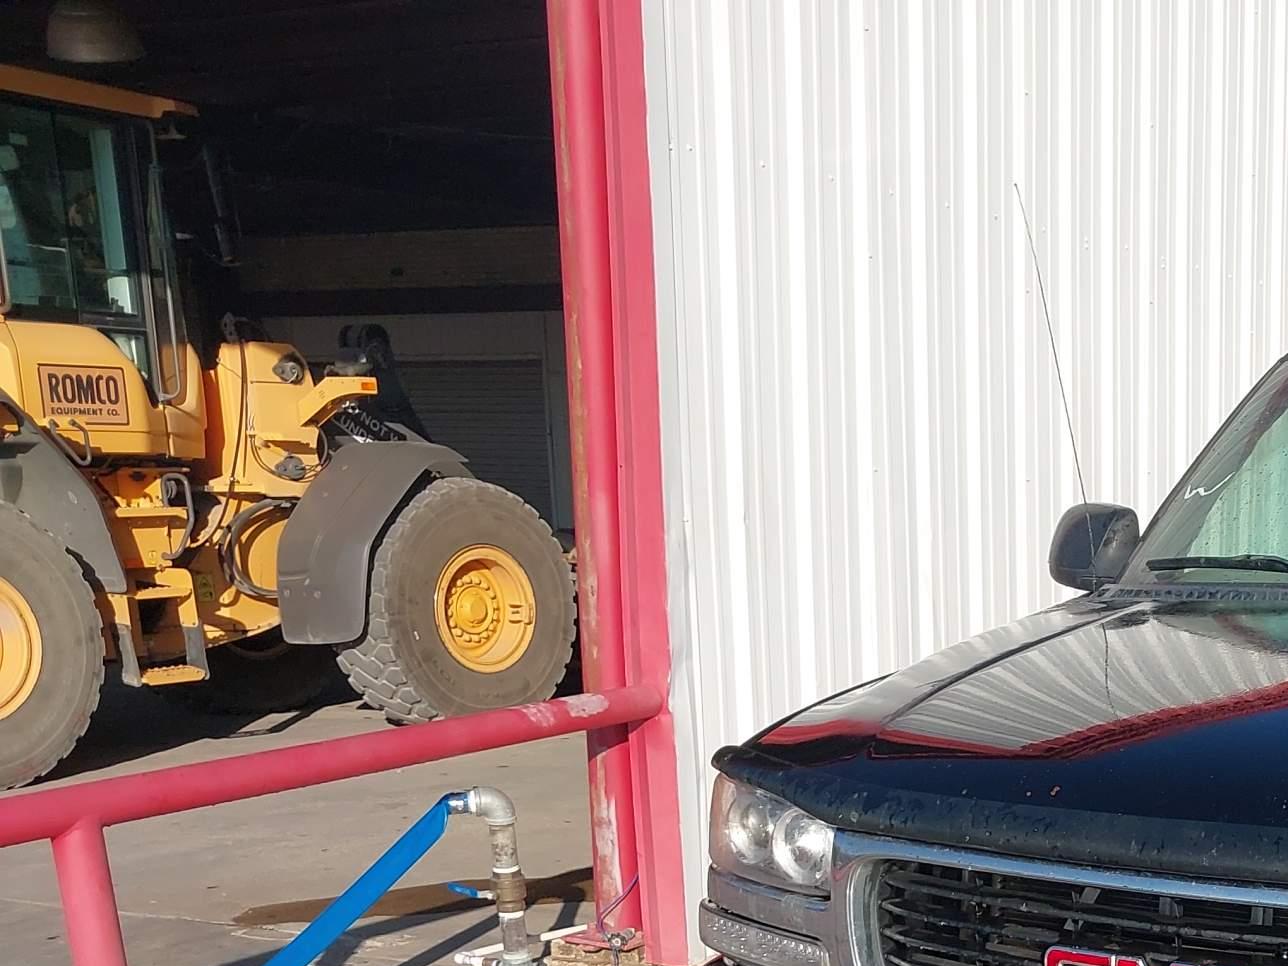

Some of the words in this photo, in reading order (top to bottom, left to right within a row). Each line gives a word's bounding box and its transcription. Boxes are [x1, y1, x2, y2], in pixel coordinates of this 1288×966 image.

[47, 372, 120, 405] ROMCO
[50, 406, 103, 416] EQUIPMENT
[107, 408, 120, 417] CO.
[360, 411, 388, 437] NOT
